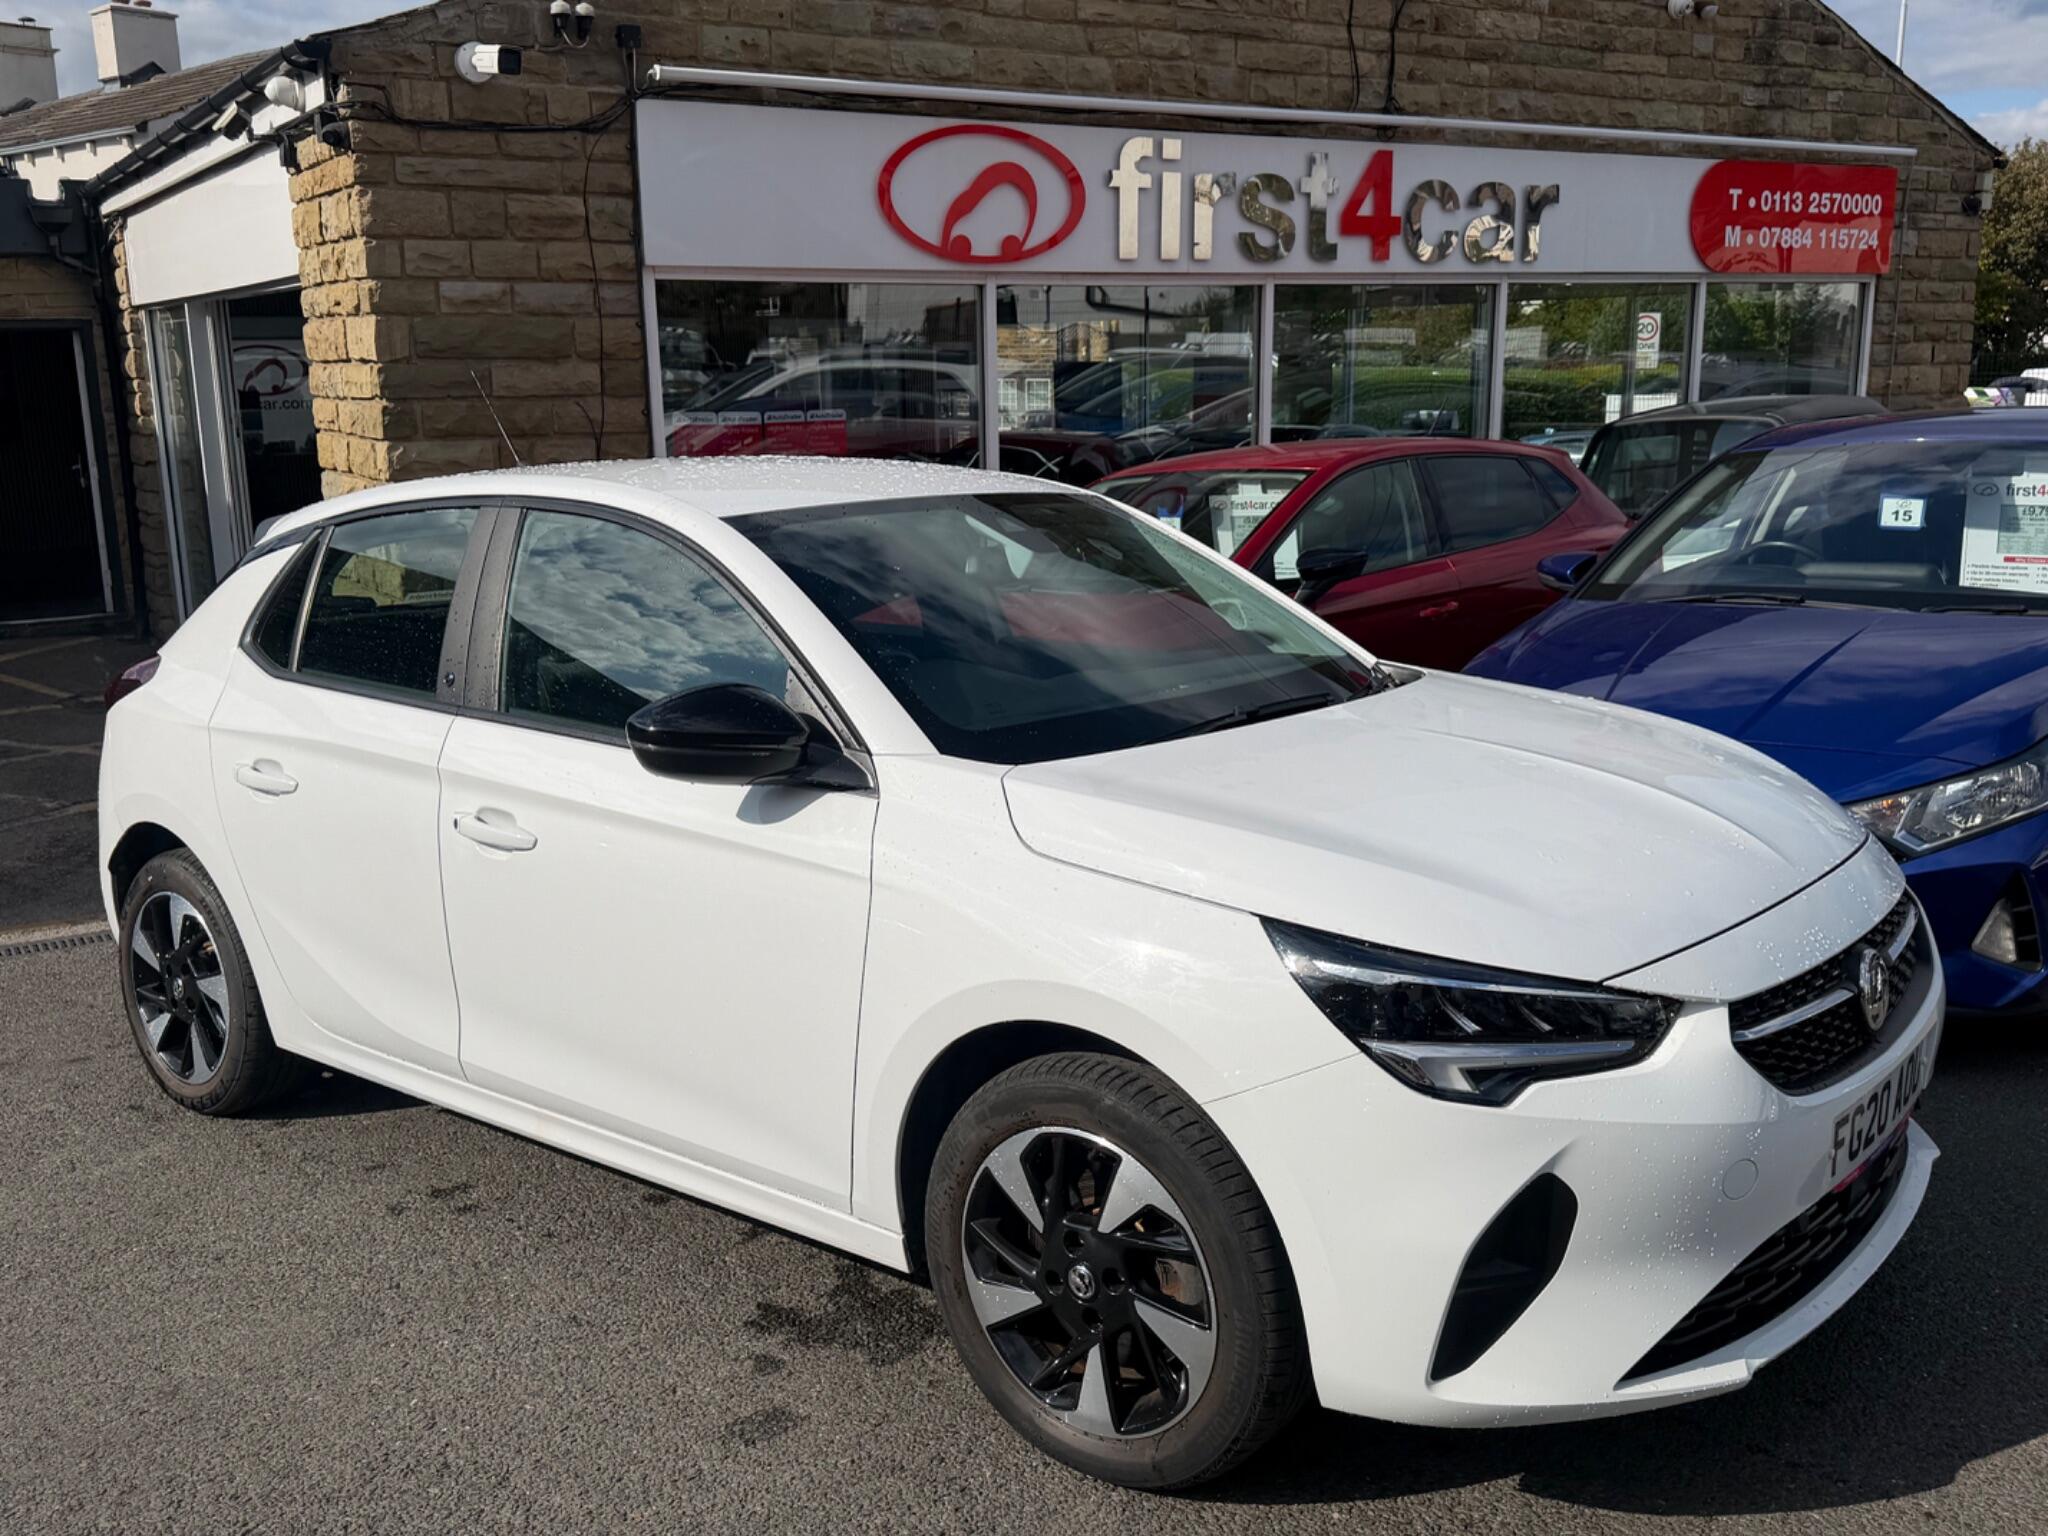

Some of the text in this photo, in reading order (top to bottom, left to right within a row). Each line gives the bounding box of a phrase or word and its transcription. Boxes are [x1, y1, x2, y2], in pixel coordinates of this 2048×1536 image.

[1108, 136, 1560, 264] first4car
[1729, 188, 1883, 215] T 0113 2570000
[1724, 225, 1879, 249] M 07884 115724
[1637, 322, 1654, 334] 20
[2006, 483, 2048, 497] first4
[1891, 510, 1912, 522] 15
[1831, 1080, 1891, 1177] FG20
